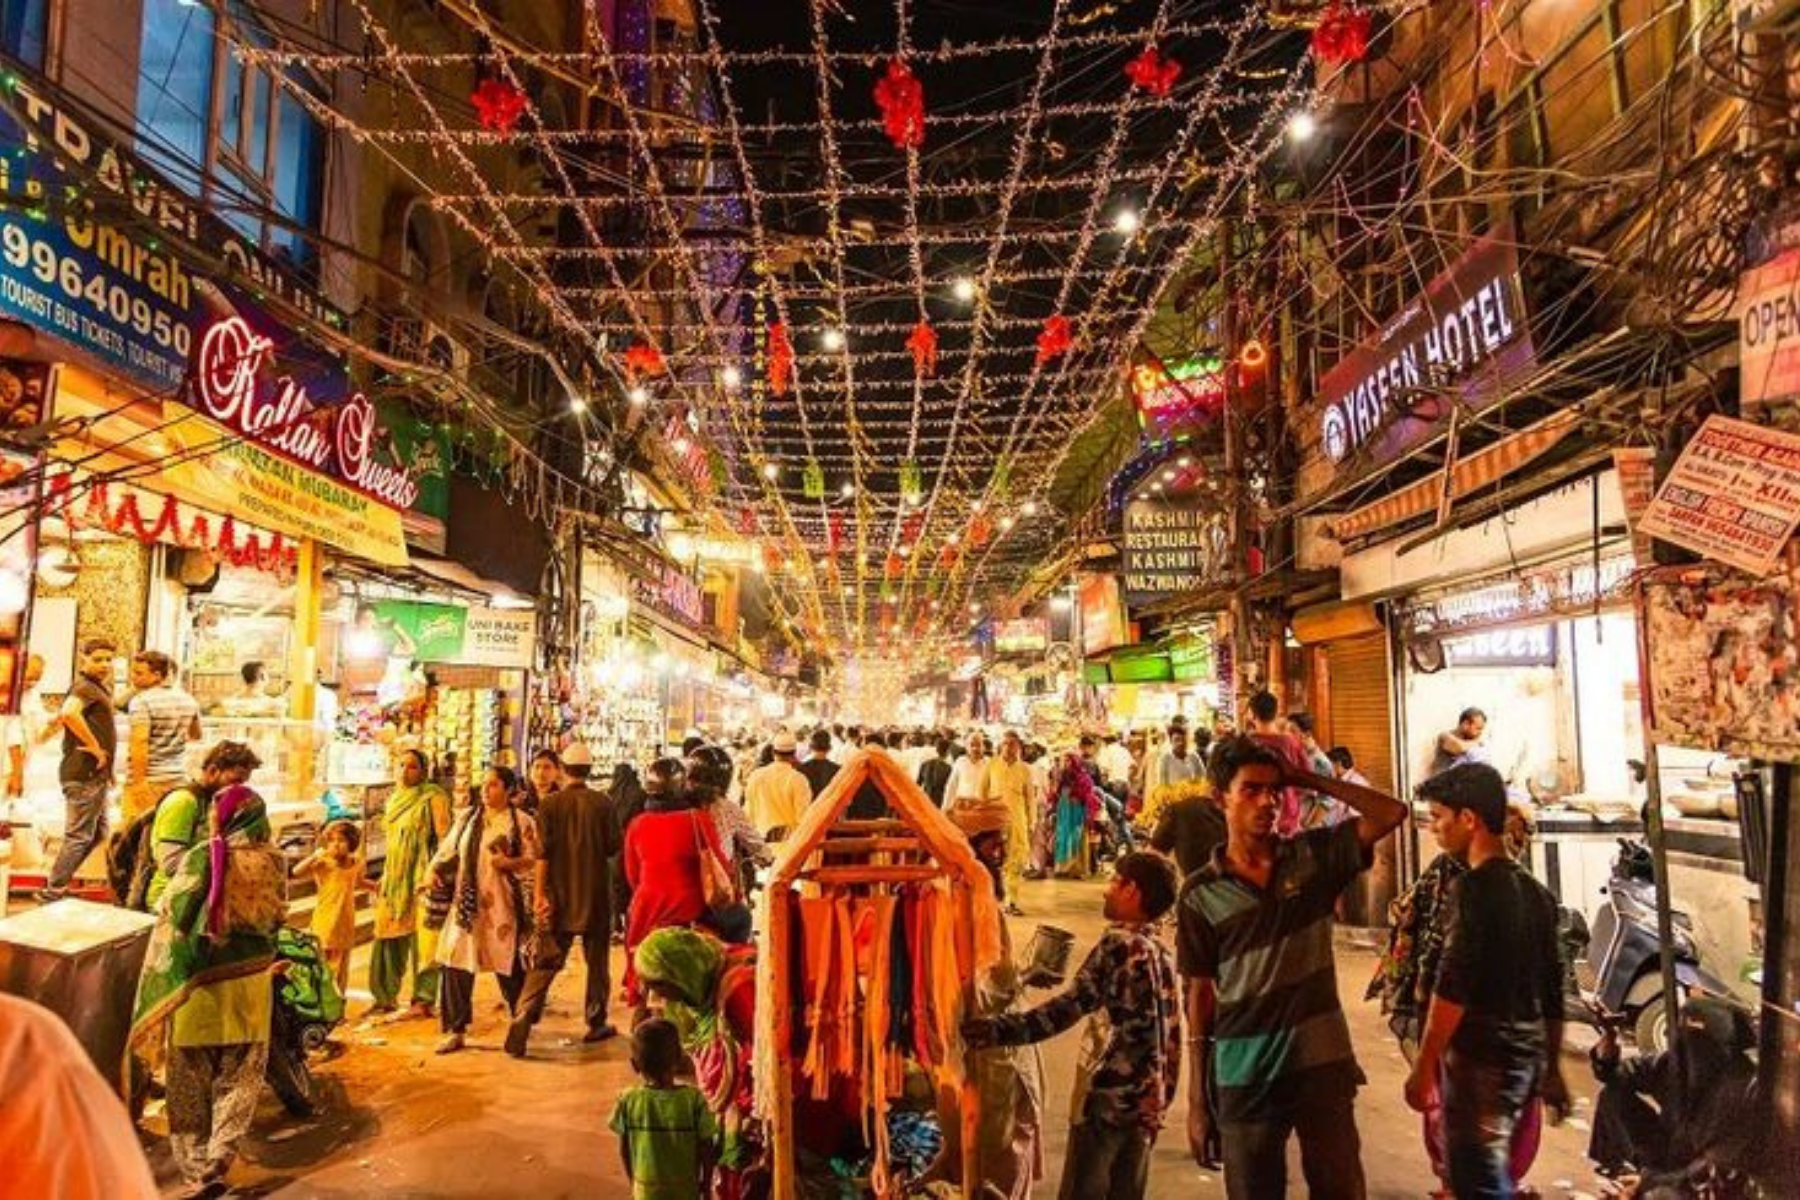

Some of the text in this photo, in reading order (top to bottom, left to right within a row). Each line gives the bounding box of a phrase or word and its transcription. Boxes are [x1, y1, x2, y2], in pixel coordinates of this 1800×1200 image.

[0, 273, 53, 320] TOURIST
[54, 303, 79, 333] BUS
[2, 222, 191, 358] 99640950
[1424, 276, 1513, 380] HOTEL
[336, 392, 419, 508] Sweets
